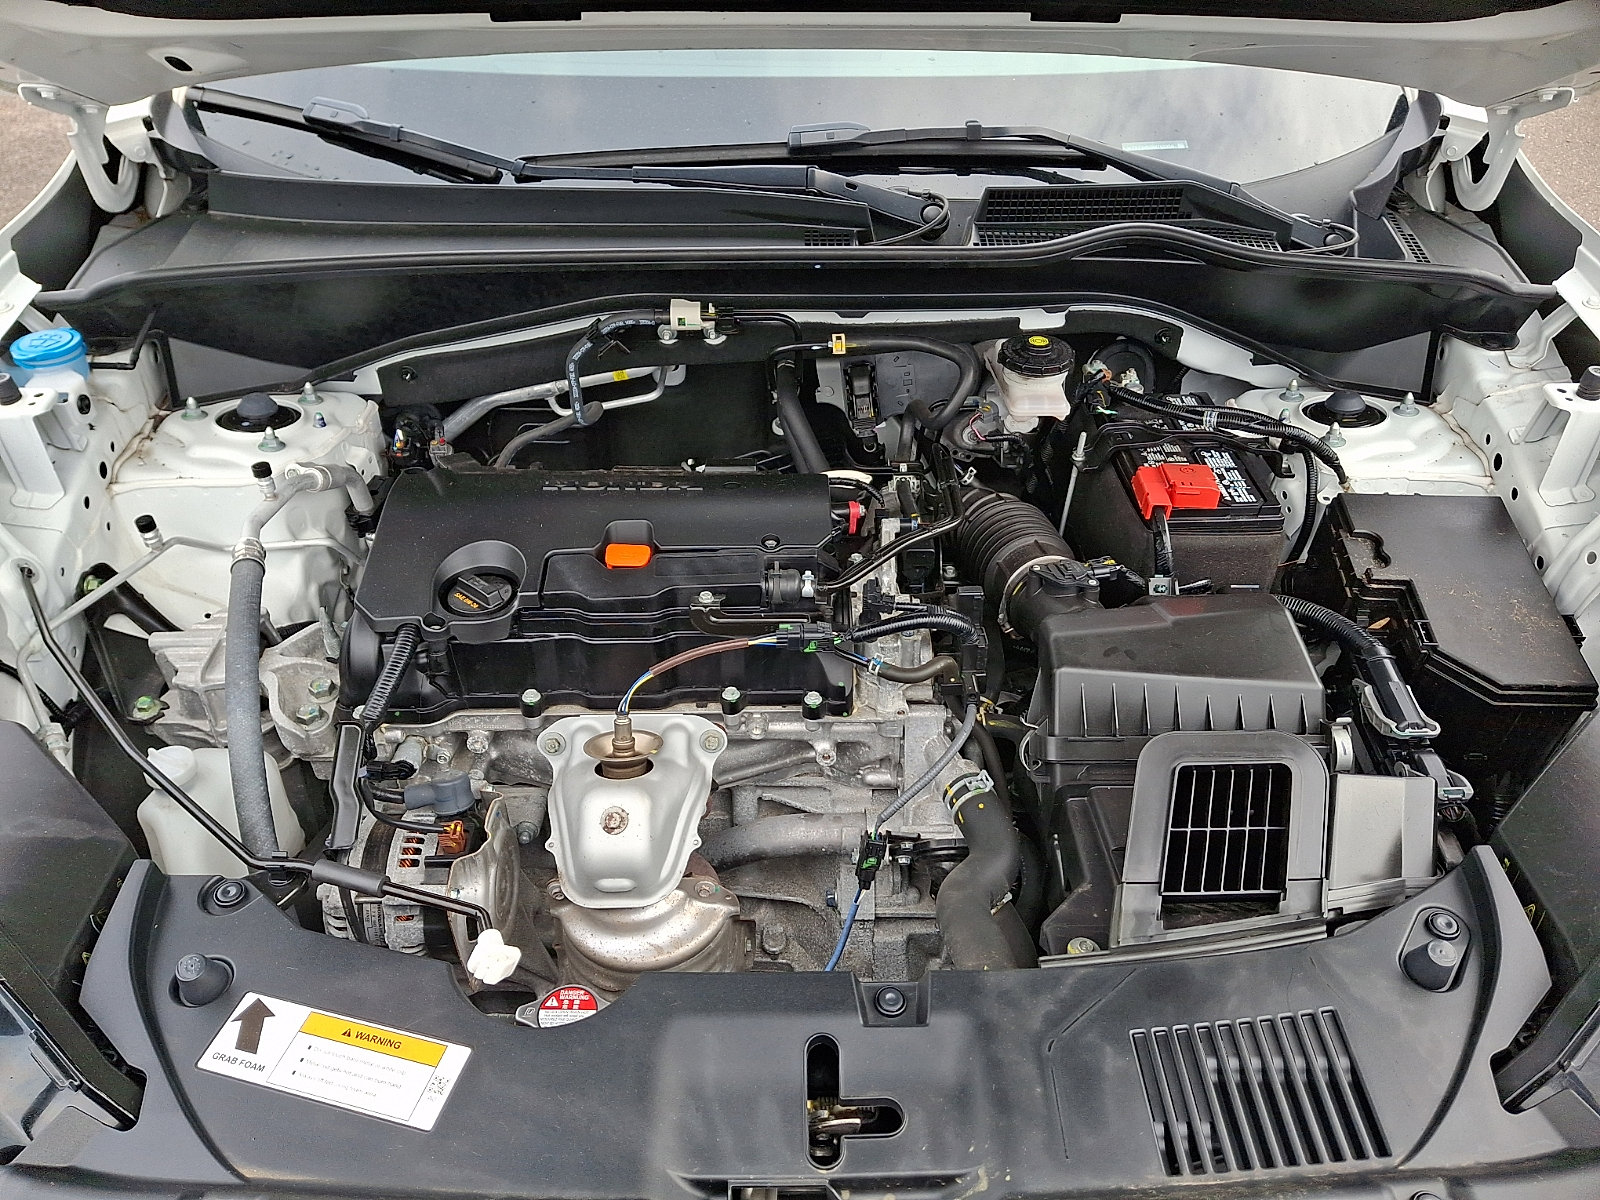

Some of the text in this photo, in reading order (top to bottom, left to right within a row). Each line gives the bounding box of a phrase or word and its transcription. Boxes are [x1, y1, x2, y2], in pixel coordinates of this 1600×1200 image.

[355, 1030, 402, 1050] WARNING
[212, 1052, 266, 1072] GRAB FOAM
